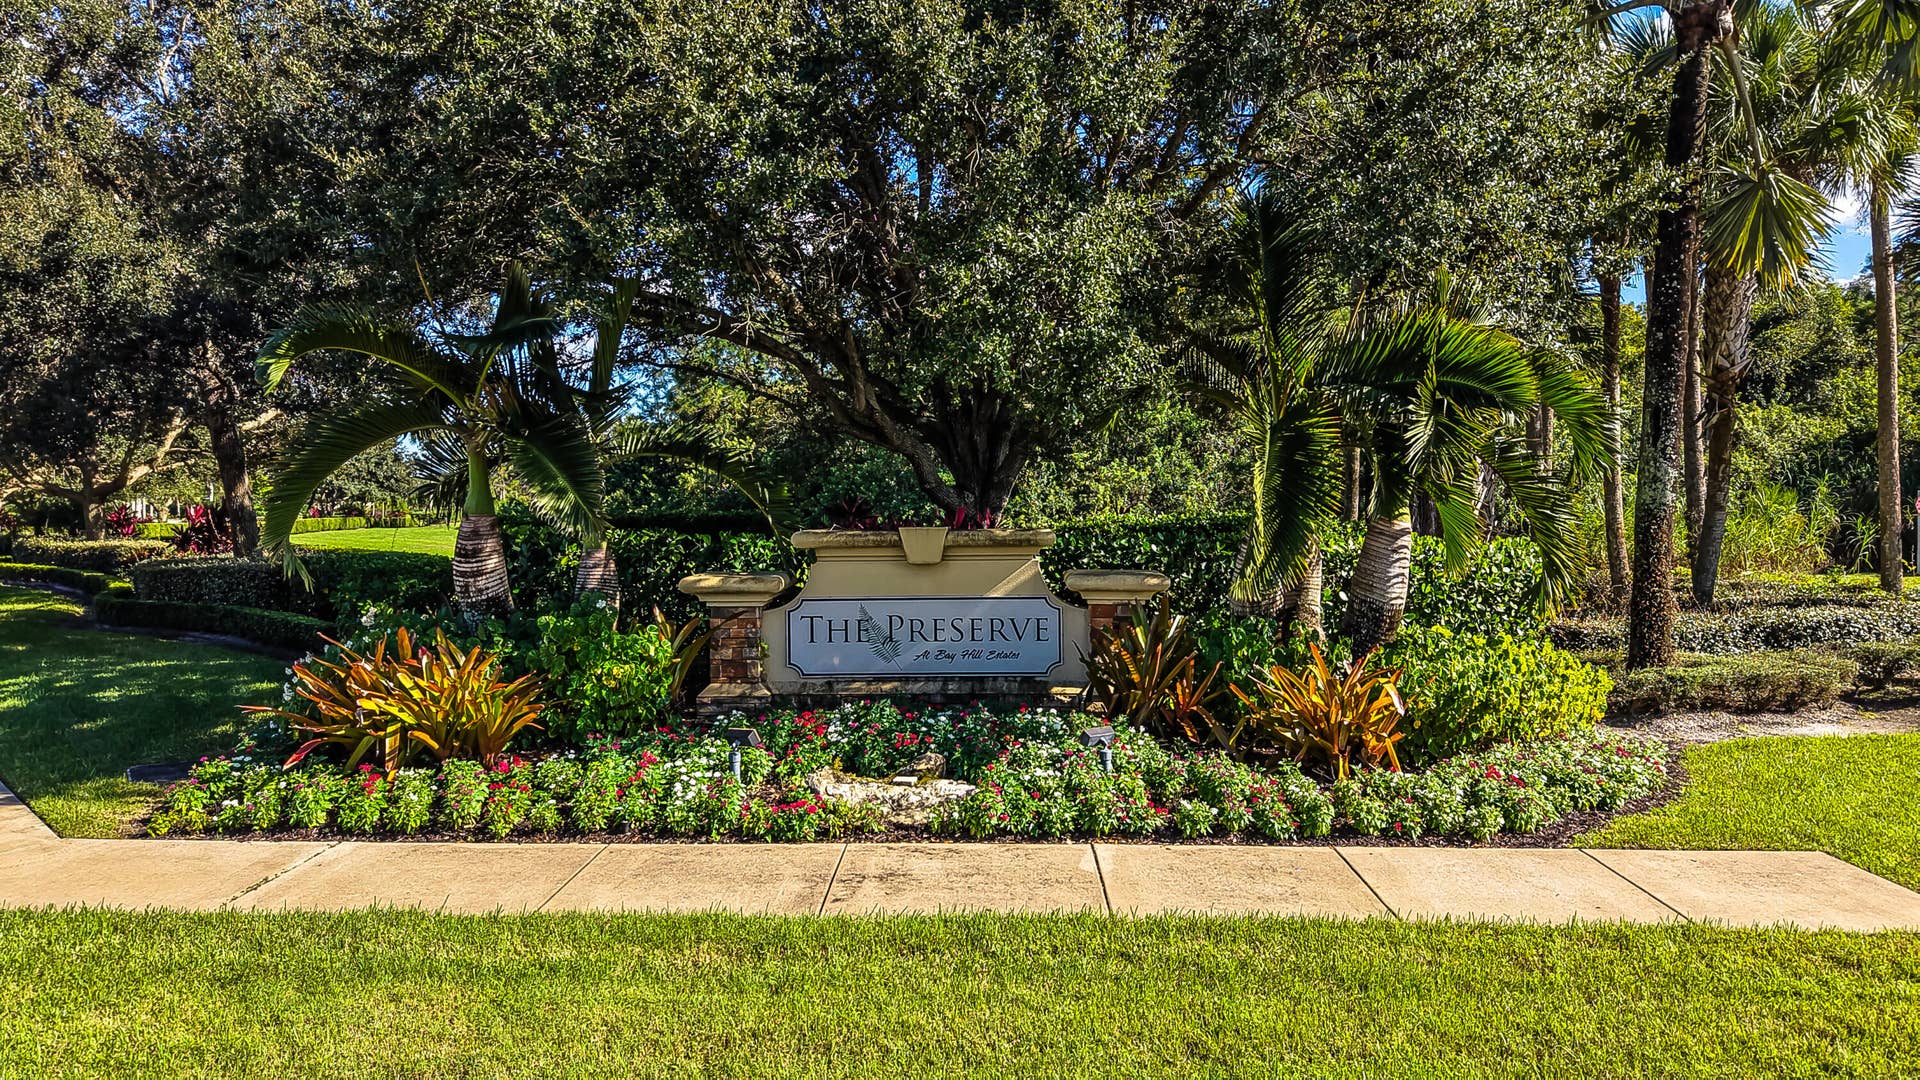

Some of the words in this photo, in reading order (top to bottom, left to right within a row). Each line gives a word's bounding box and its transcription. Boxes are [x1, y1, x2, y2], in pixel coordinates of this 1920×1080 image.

[800, 615, 871, 644] THE
[887, 614, 1050, 643] PRESERVE
[913, 649, 931, 662] At
[934, 649, 957, 664] Bay
[960, 648, 984, 661] Hill
[985, 649, 1021, 661] Estates
